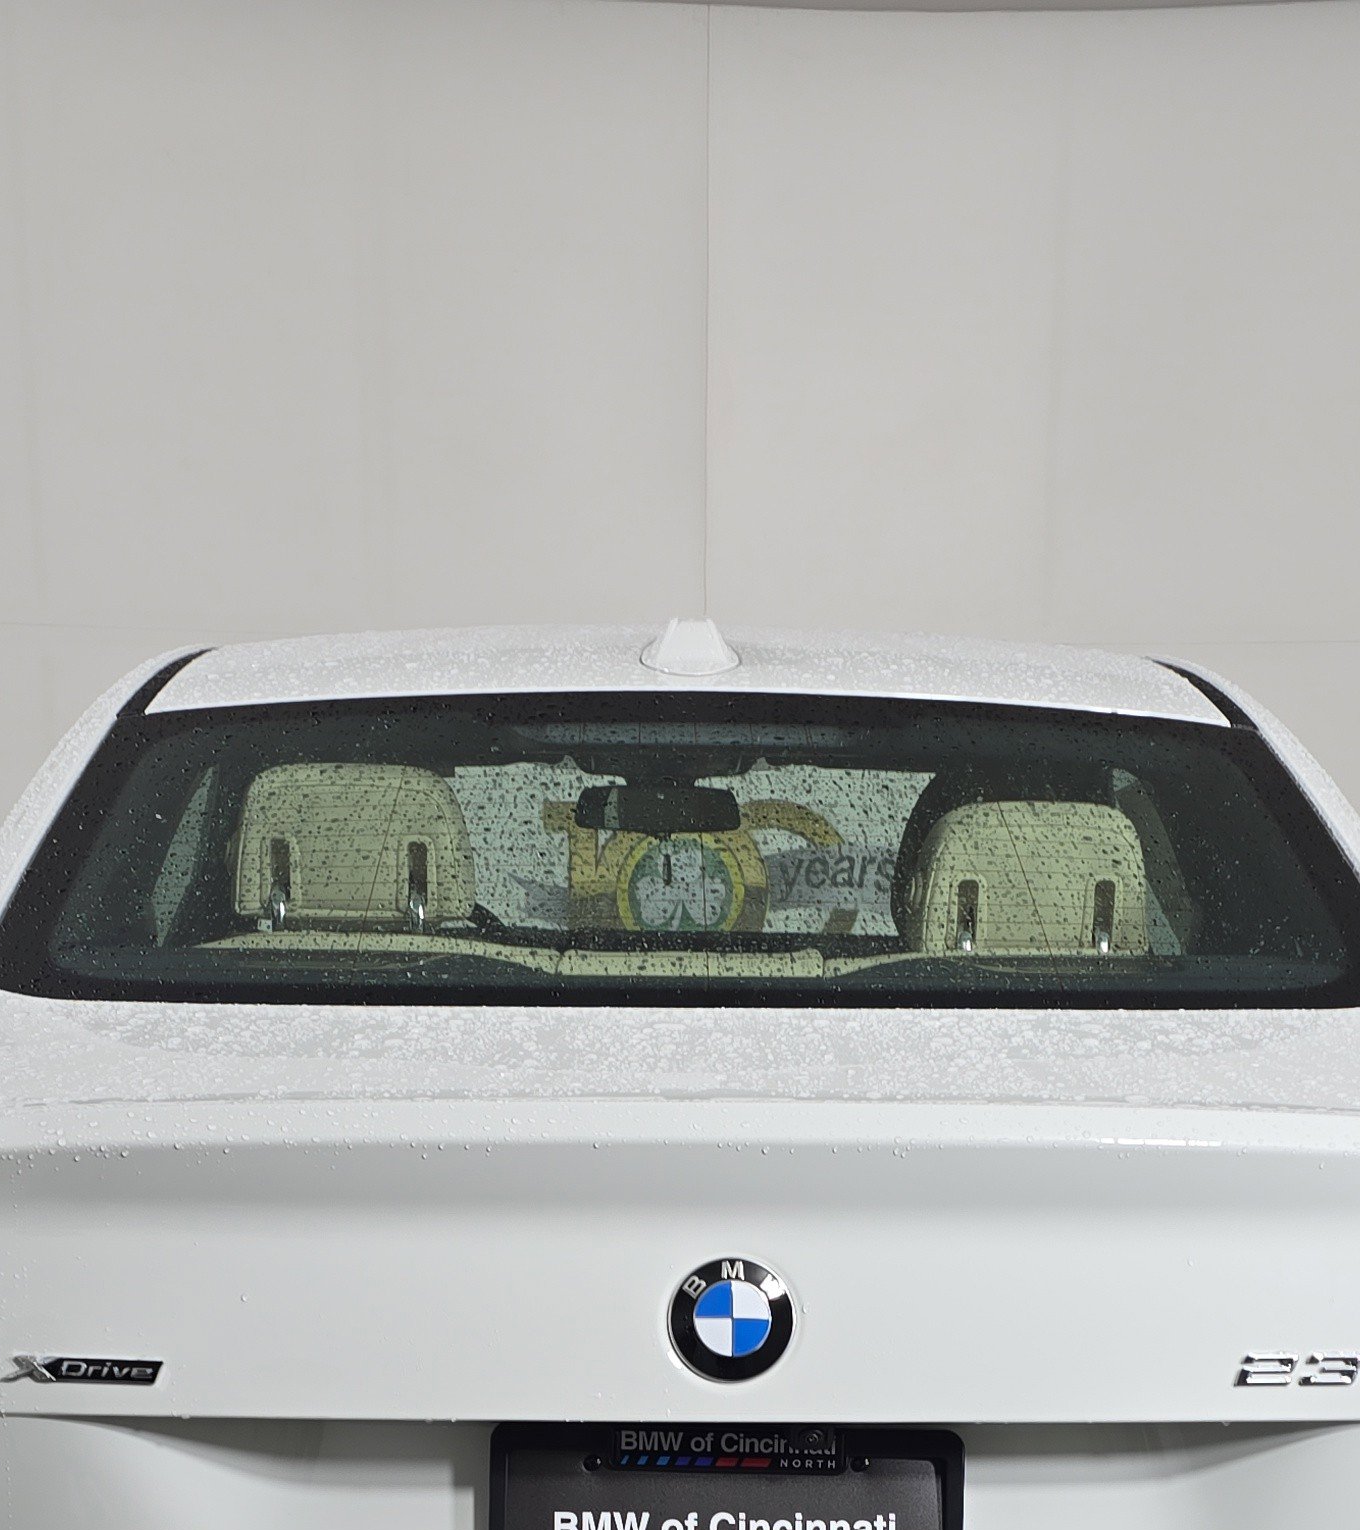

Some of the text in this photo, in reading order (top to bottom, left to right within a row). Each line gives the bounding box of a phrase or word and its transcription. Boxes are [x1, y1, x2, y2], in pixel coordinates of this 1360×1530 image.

[621, 1430, 683, 1450] BMW
[690, 1432, 714, 1452] of
[779, 1458, 836, 1469] NORTH
